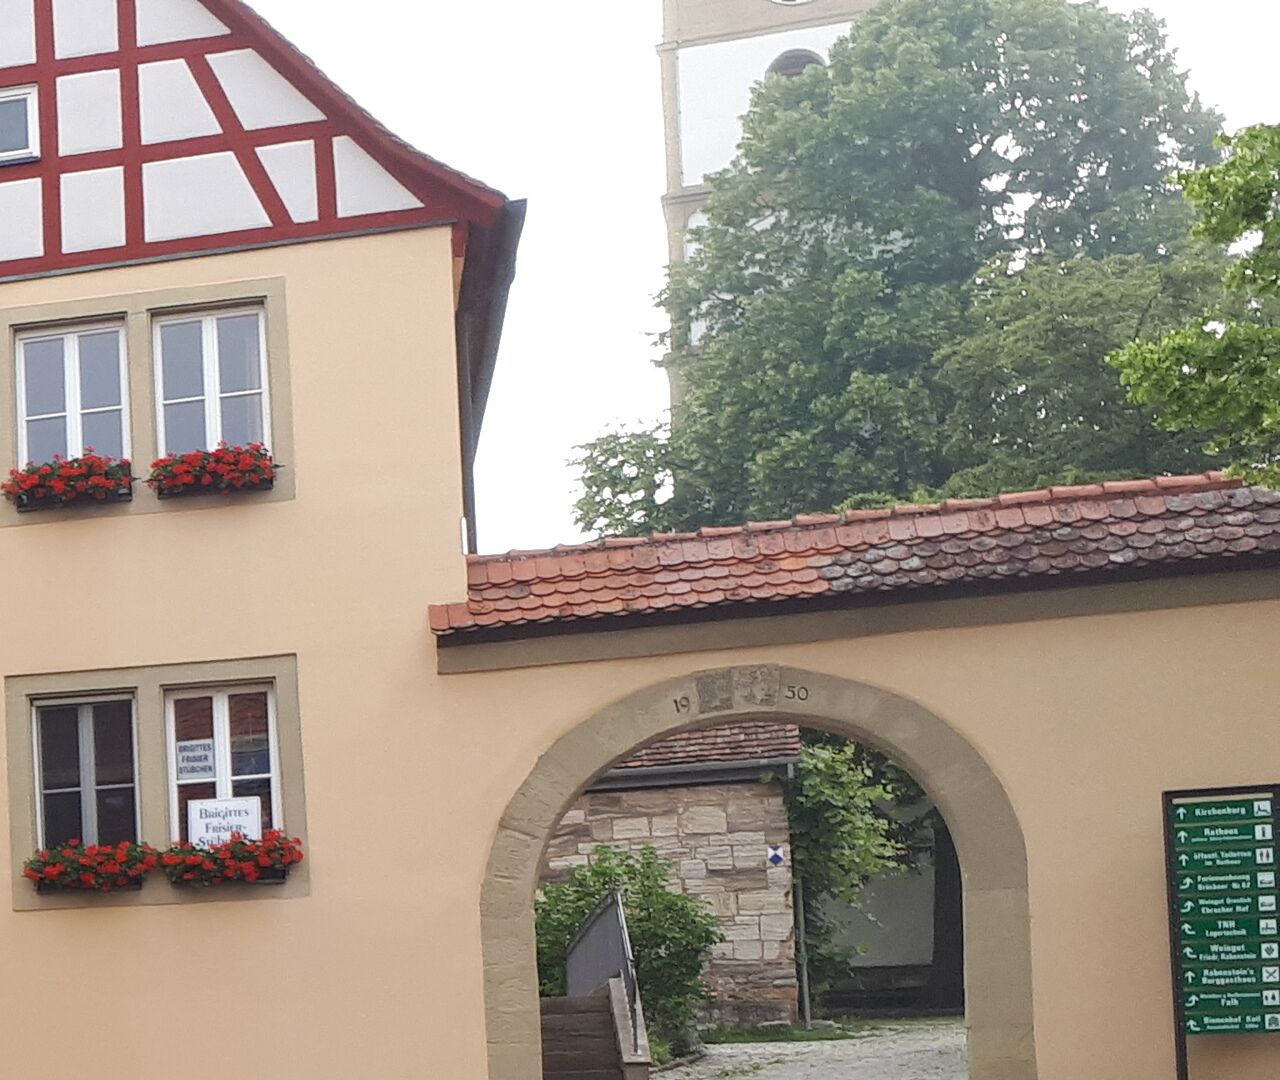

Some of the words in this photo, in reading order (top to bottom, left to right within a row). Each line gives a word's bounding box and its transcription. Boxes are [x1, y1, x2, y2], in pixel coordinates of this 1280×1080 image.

[785, 686, 809, 701] 50
[673, 697, 690, 714] 19
[178, 744, 212, 752] BRIGITTES
[1194, 806, 1246, 816] Kirchenburg
[1204, 828, 1238, 836] Rathaus
[1217, 920, 1236, 928] TNH
[1210, 944, 1246, 952] Weingut
